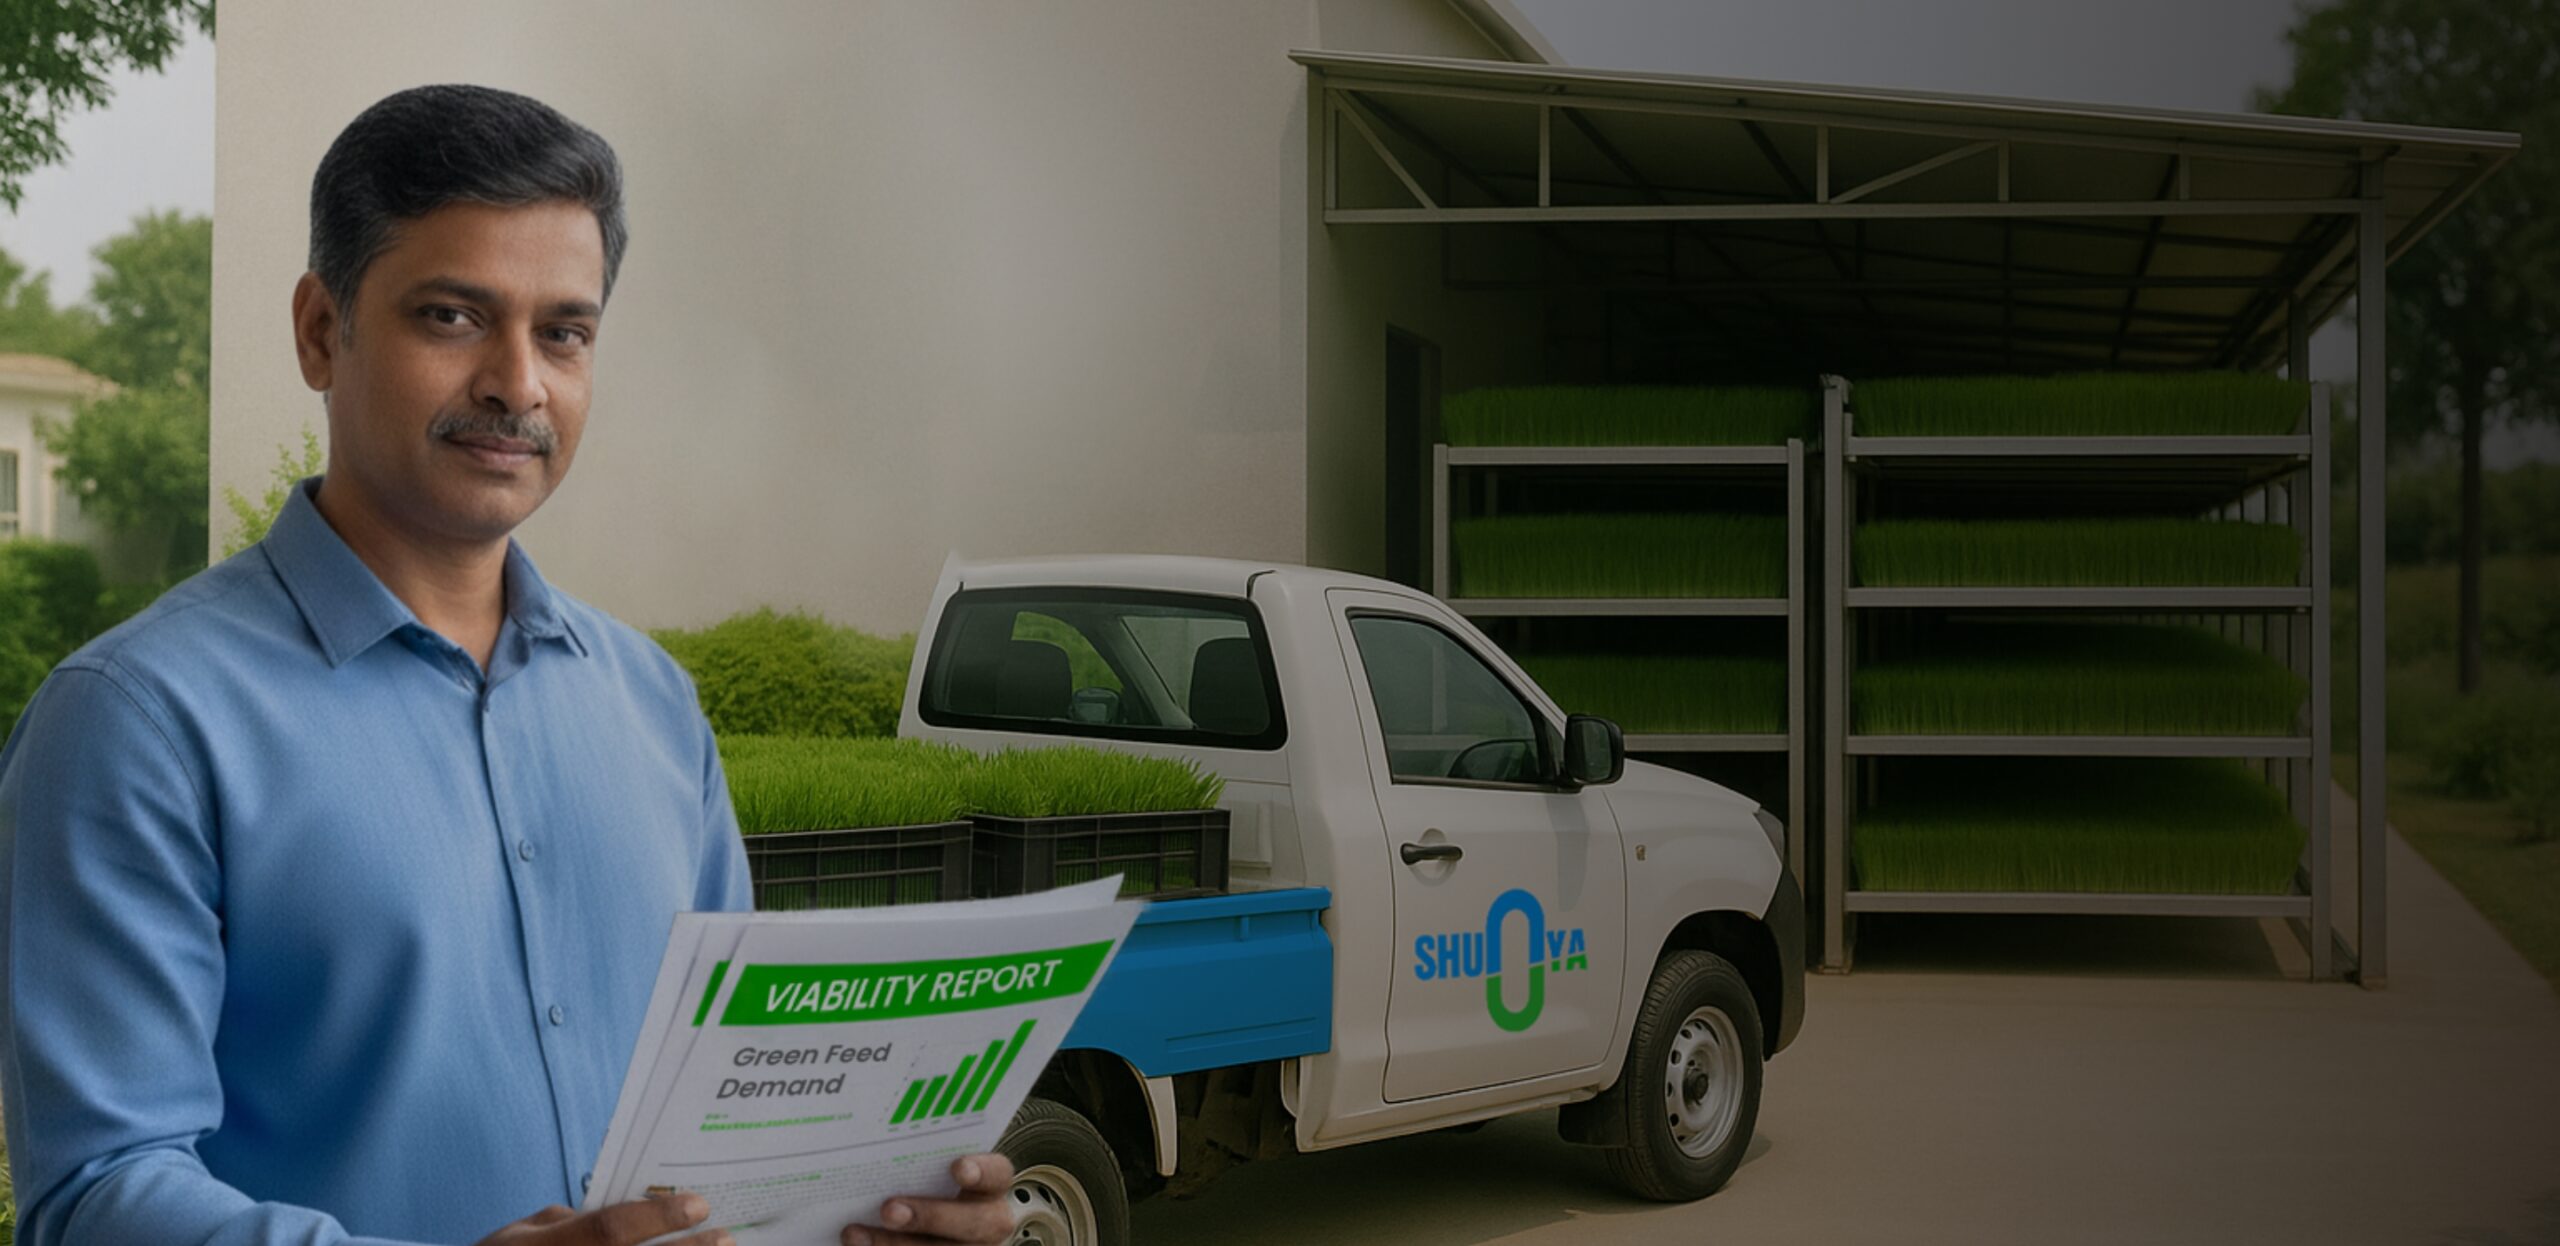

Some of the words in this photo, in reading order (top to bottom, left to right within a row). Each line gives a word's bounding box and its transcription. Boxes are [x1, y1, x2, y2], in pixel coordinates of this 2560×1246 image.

[765, 974, 926, 1013] VIABILITY
[929, 960, 1062, 1002] REPORT
[734, 1046, 819, 1067] Green
[825, 1043, 892, 1064] Feed
[716, 1074, 846, 1100] Demand
